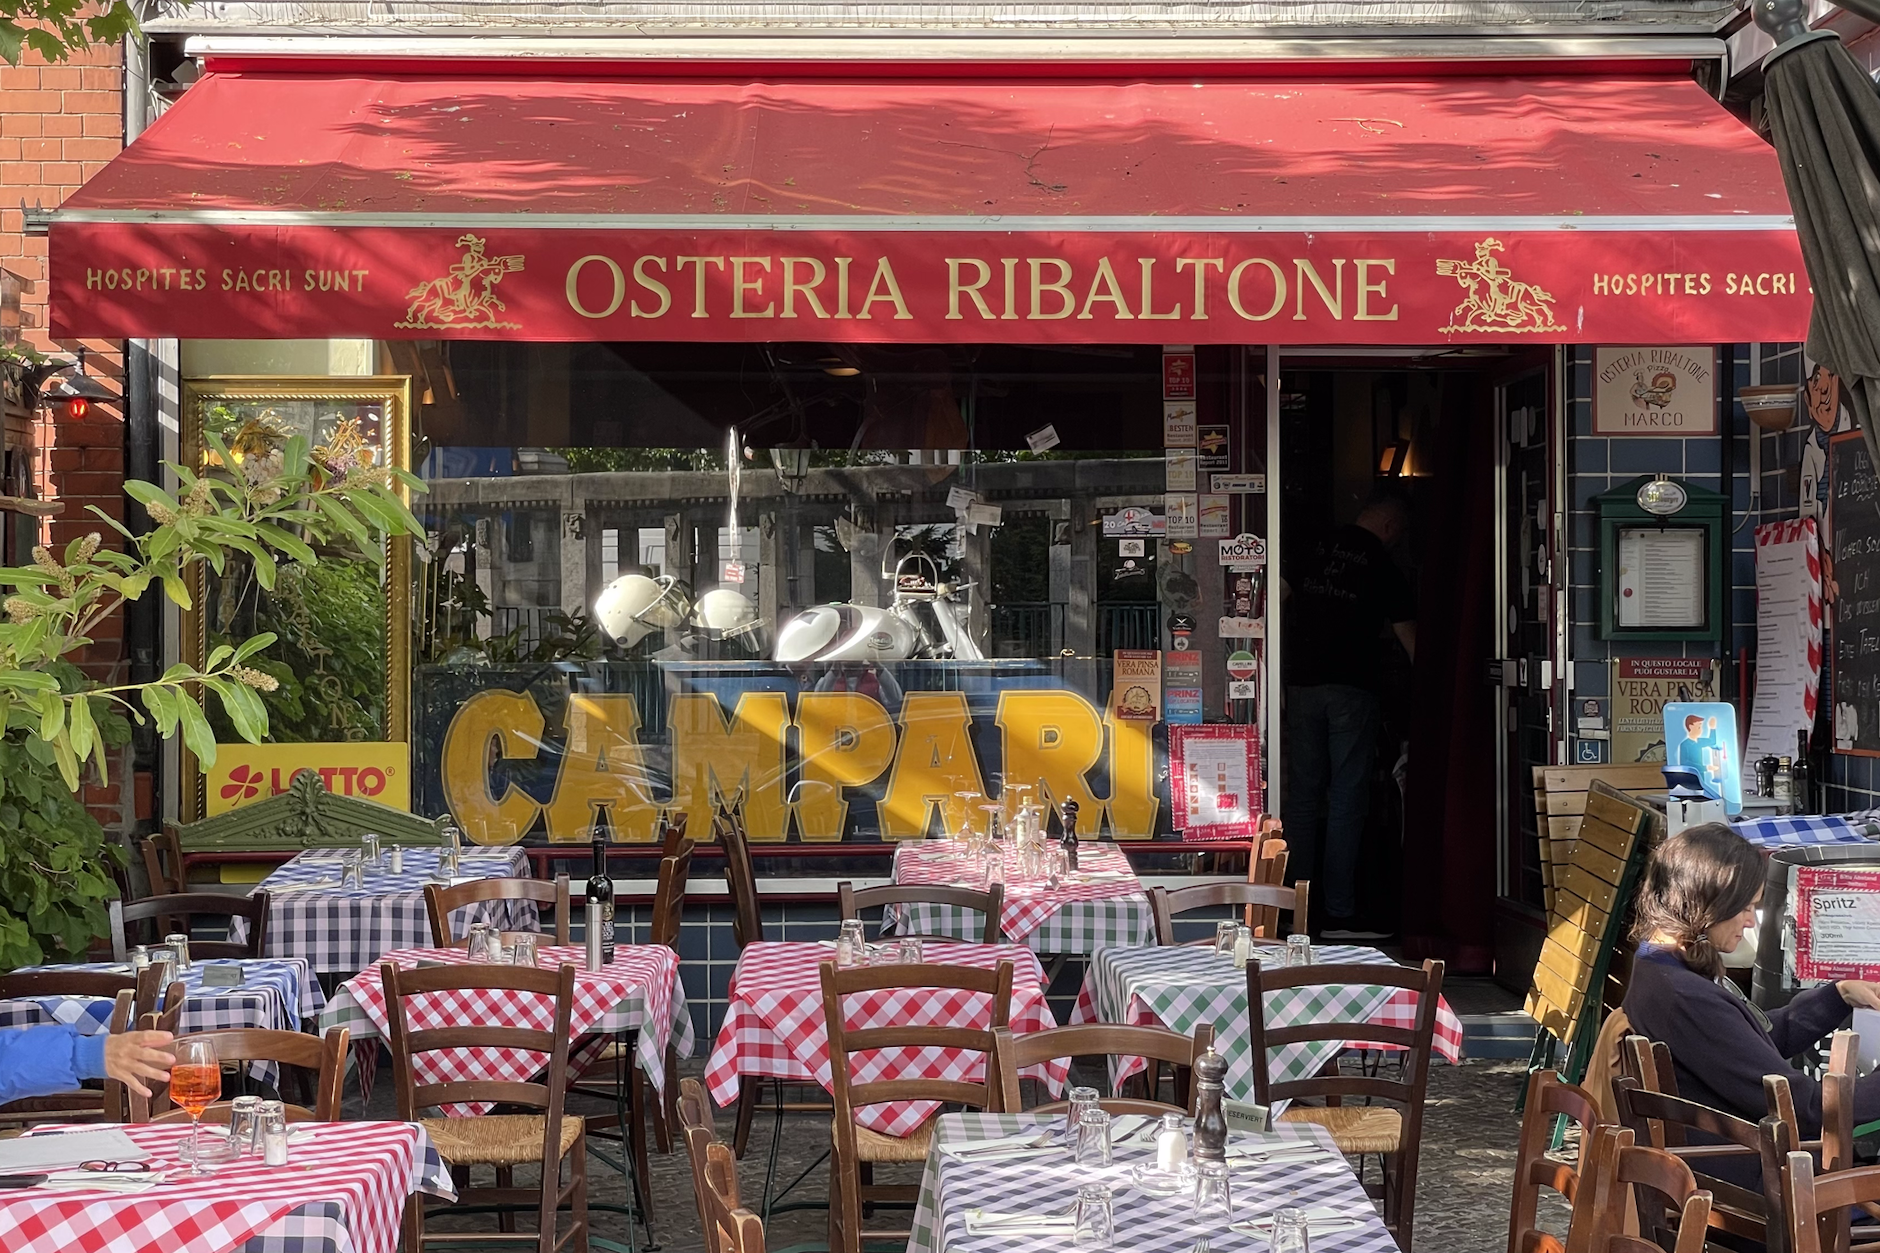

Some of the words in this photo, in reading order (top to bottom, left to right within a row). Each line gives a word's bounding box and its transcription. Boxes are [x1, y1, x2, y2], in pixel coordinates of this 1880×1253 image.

[86, 267, 208, 292] HOSPITES
[221, 268, 291, 292] SACRI
[304, 269, 369, 292] SUNT
[1592, 272, 1712, 295] HOSPITES
[1725, 273, 1796, 295] SACRI
[566, 254, 914, 320] OSTERIA
[944, 256, 1398, 322] RIBALTONE
[1600, 351, 1645, 384] OSTERIA
[1651, 349, 1710, 384] RIBALTONE
[1624, 412, 1683, 427] MARCO
[1168, 471, 1182, 479] TOP
[1185, 471, 1194, 479] 10
[1104, 520, 1116, 529] 20
[1168, 516, 1183, 524] TOP
[1185, 516, 1195, 524] 10
[1221, 545, 1265, 556] MOTO
[1323, 560, 1346, 577] del
[1166, 652, 1200, 661] PRINZ
[1117, 660, 1136, 668] VERA
[1138, 660, 1159, 669] PINSA
[1641, 660, 1671, 668] QUESTO
[1122, 668, 1155, 676] ROMANA
[1167, 690, 1200, 698] PRINZ
[1617, 681, 1662, 698] VERA
[442, 690, 1161, 846] CAMPARI
[1813, 898, 1857, 912] Spritz
[1228, 1110, 1263, 1123] ESERVIERT
